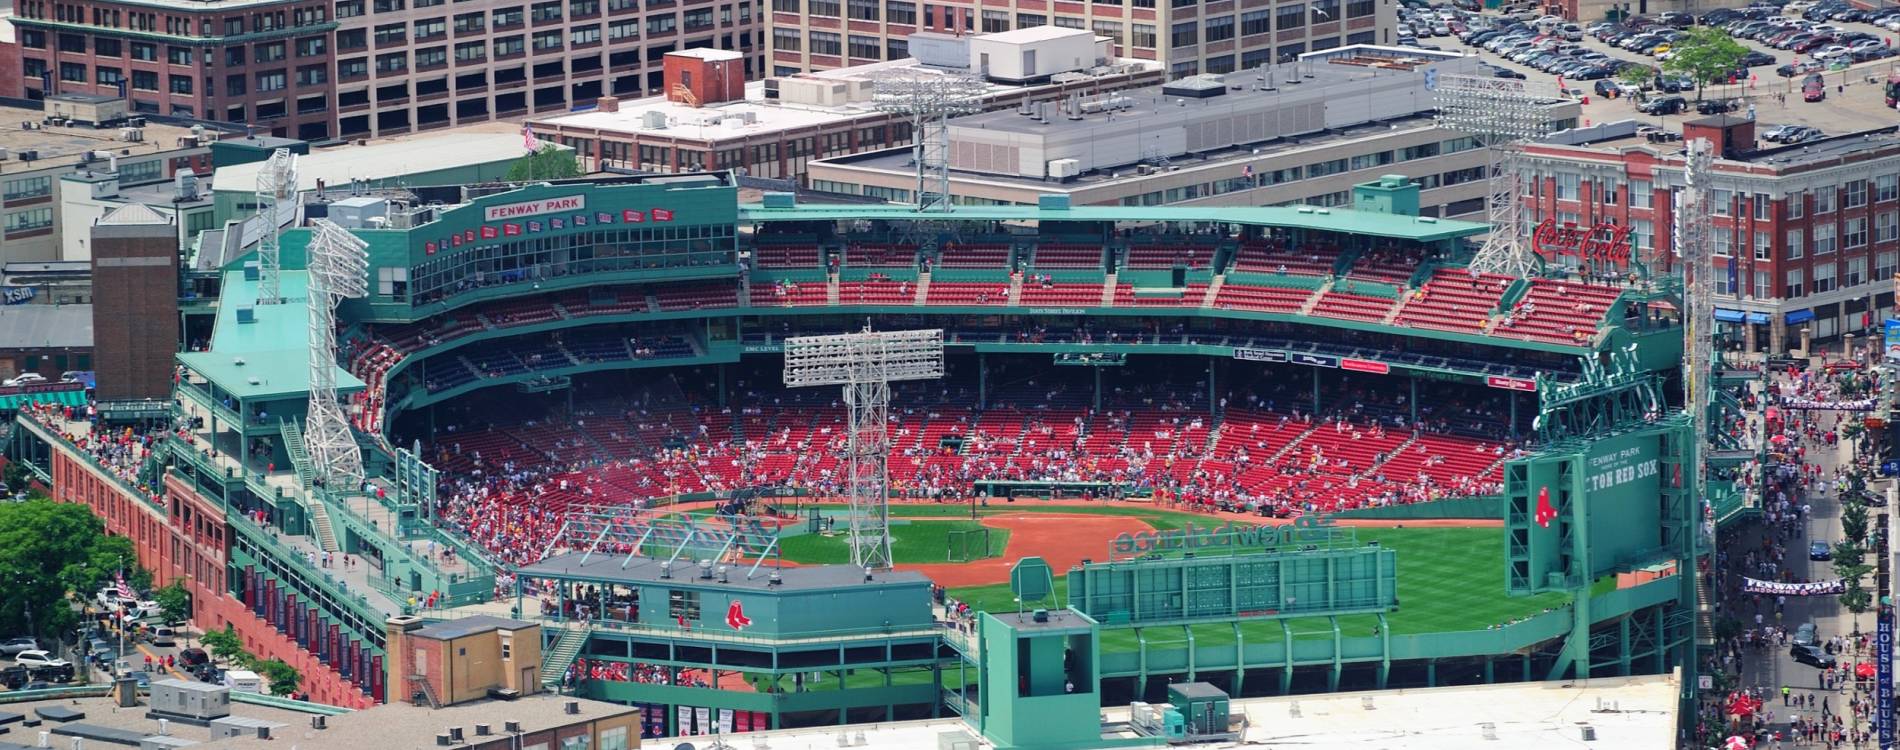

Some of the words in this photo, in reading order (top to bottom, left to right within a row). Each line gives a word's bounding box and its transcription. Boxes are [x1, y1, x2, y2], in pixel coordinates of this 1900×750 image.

[490, 202, 540, 218] FENWAY
[546, 198, 579, 210] PARK
[1620, 446, 1641, 459] PARK
[1615, 465, 1635, 485] RED
[1637, 459, 1658, 479] SOX
[1744, 586, 1797, 595] LANSDOWNE
[1747, 579, 1802, 591] FENWAY
[1805, 580, 1841, 591] PARK
[1879, 622, 1890, 674] HOUSE
[1880, 687, 1890, 740] BLUES
